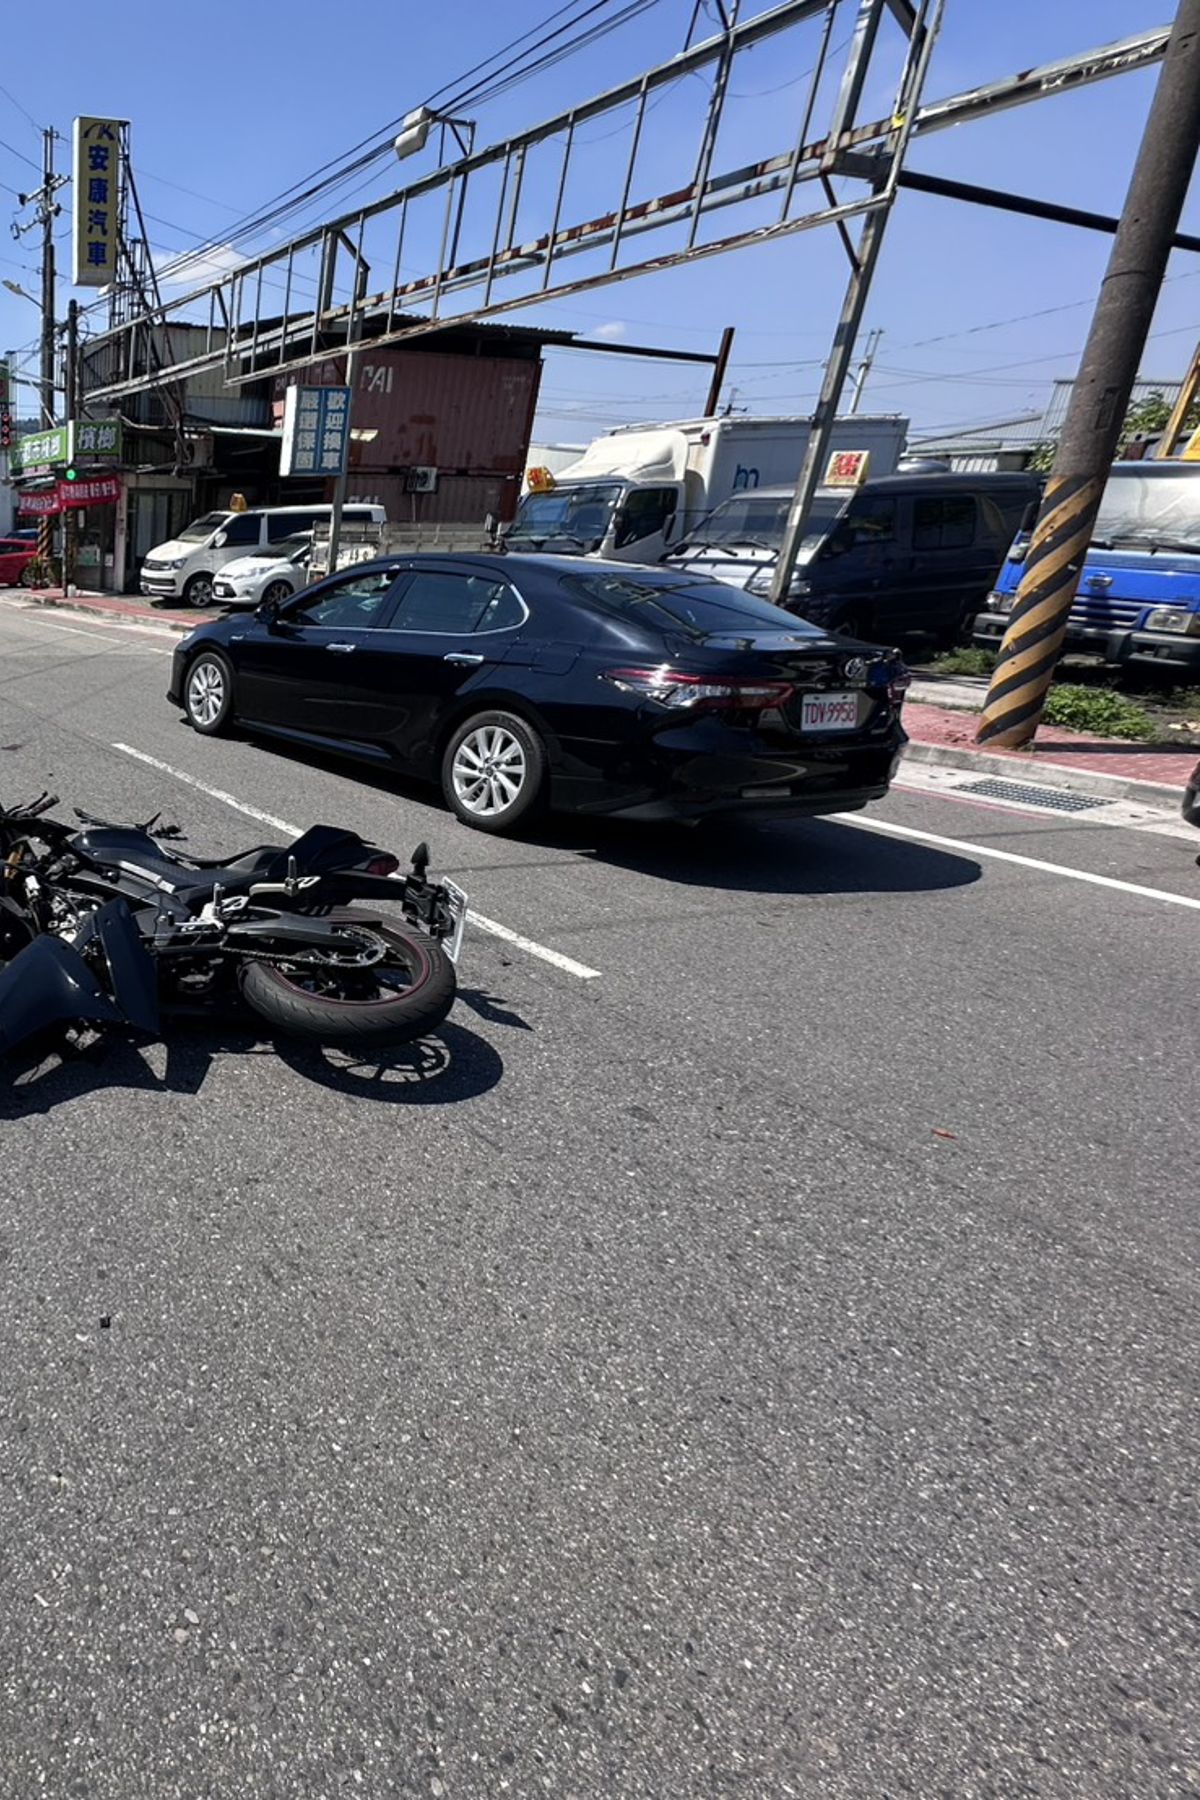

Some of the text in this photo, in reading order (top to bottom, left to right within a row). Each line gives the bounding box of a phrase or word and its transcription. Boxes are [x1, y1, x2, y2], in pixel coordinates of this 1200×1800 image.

[87, 144, 109, 266] 安康汽車
[78, 425, 116, 450] 檳榔
[322, 391, 346, 470] 歡迎換車
